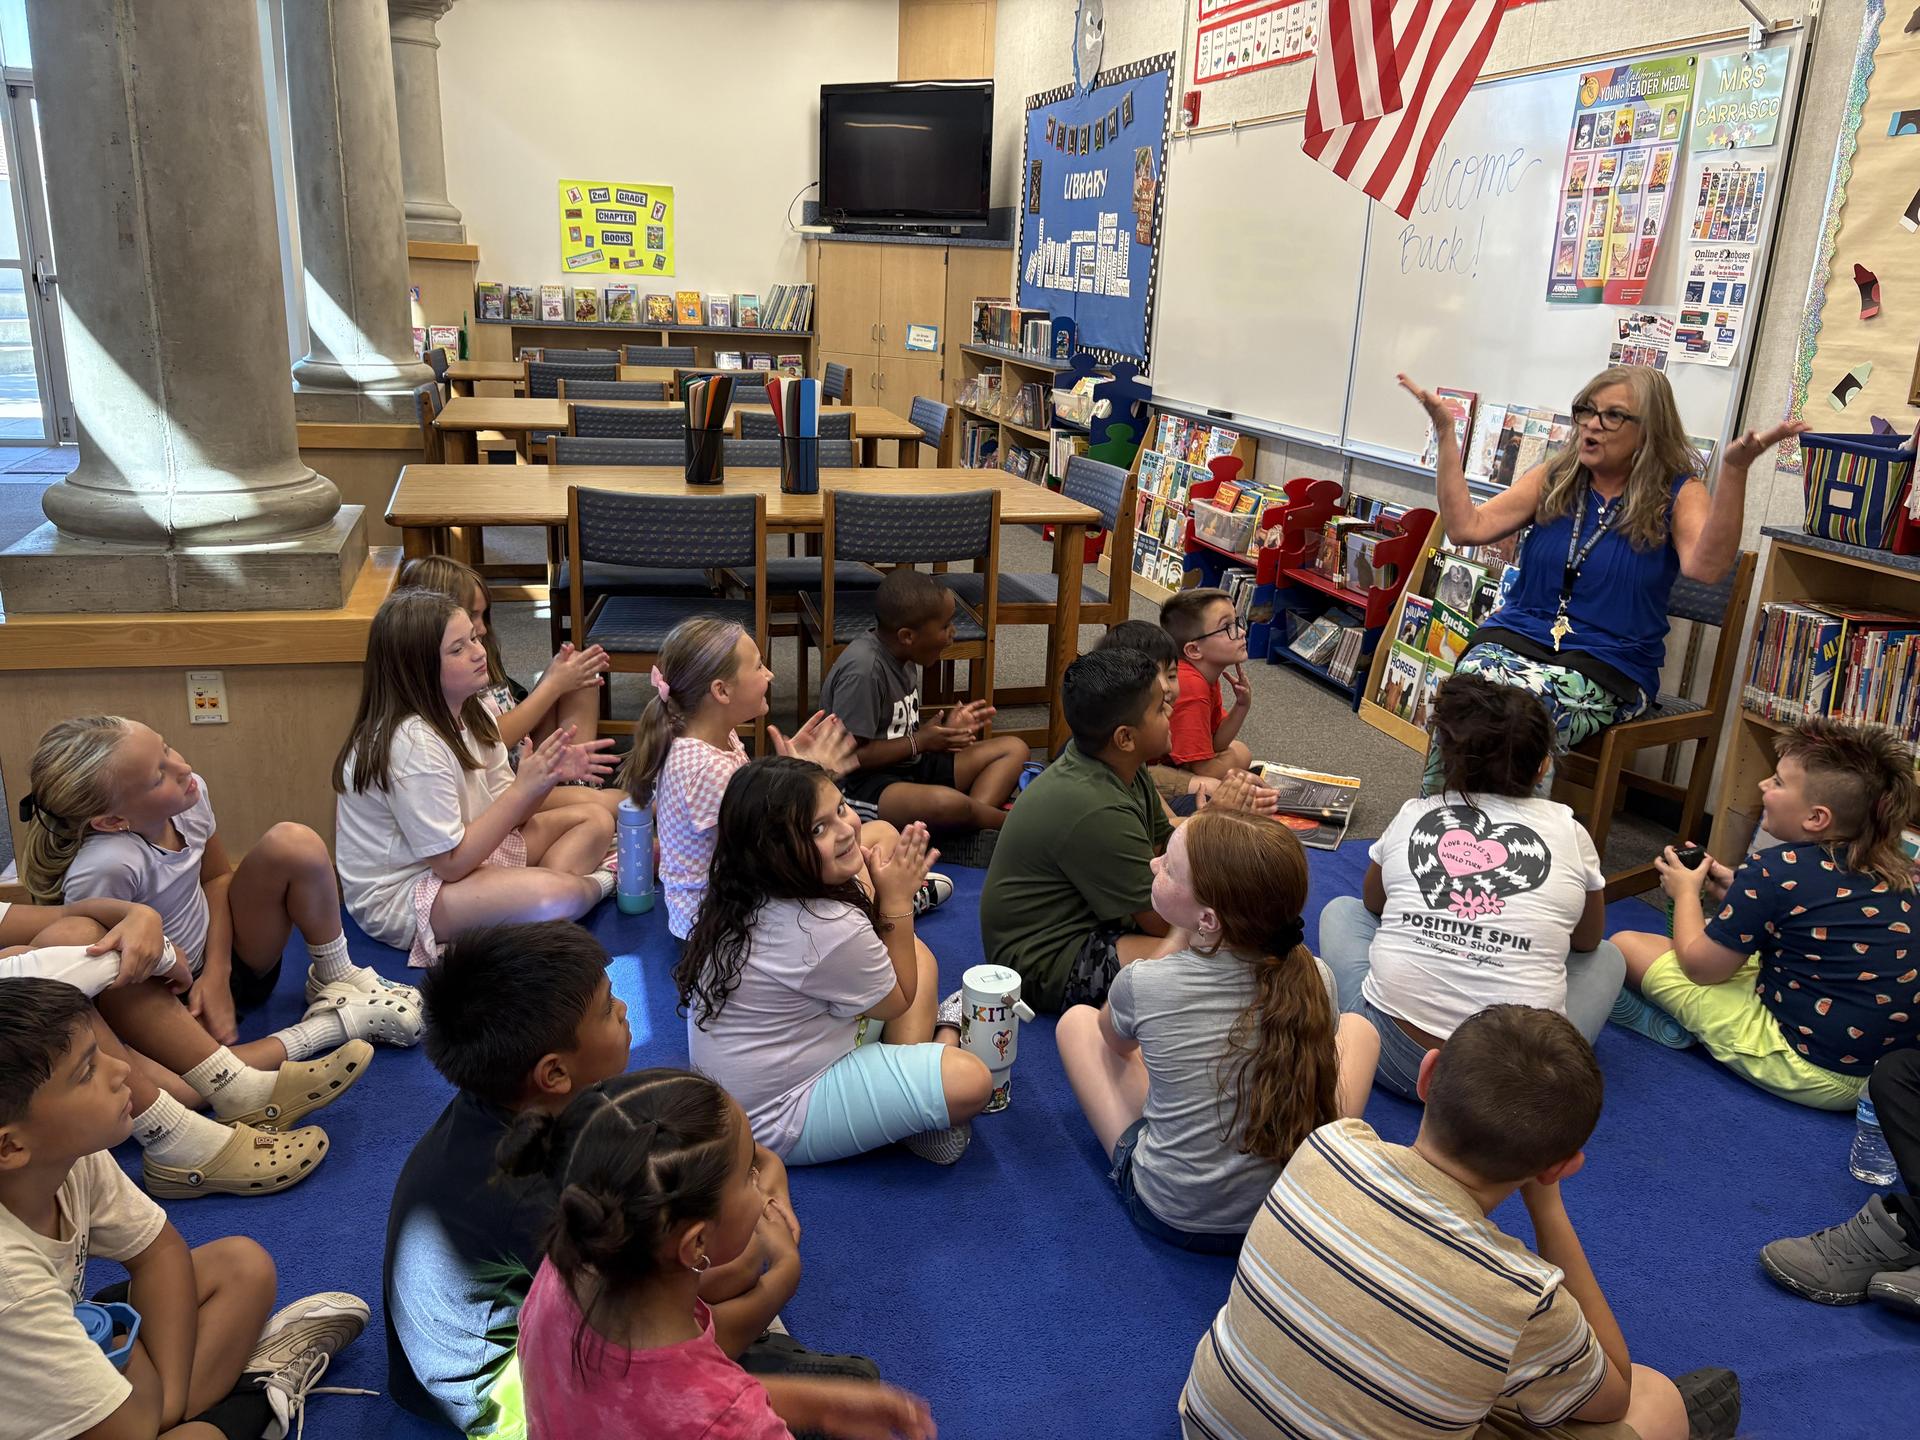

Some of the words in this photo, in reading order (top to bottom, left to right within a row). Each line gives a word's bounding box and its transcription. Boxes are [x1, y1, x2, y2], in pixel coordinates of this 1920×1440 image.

[1600, 84, 1625, 102] YOUNG
[1626, 77, 1659, 98] READER
[1661, 73, 1690, 93] MEDAL
[1719, 63, 1767, 94] MRS
[1695, 97, 1781, 128] CARRASCO
[1063, 167, 1109, 200] LIBRARY
[1419, 142, 1542, 215] elcome
[592, 191, 608, 200] 2nd
[619, 192, 645, 204] GRADE
[598, 211, 634, 223] CHAPTER
[604, 233, 630, 243] BOOKS
[1399, 215, 1485, 279] Back!
[1694, 249, 1719, 259] Online
[1440, 609, 1470, 638] Ducks
[1390, 655, 1418, 679] HORSES
[1441, 851, 1464, 864] WORLD
[1465, 859, 1482, 870] TURN
[1444, 840, 1461, 848] LOVE
[1463, 841, 1485, 853] MAKES
[1484, 852, 1494, 865] THE
[1402, 912, 1483, 940] POSITIVE
[1488, 930, 1532, 952] SPIN
[1421, 929, 1467, 946] RECORD
[1470, 940, 1503, 955] SHOP
[1413, 936, 1425, 946] Los
[1425, 940, 1459, 957] Angeles
[1465, 951, 1505, 969] California
[213, 1071, 238, 1092] adidas
